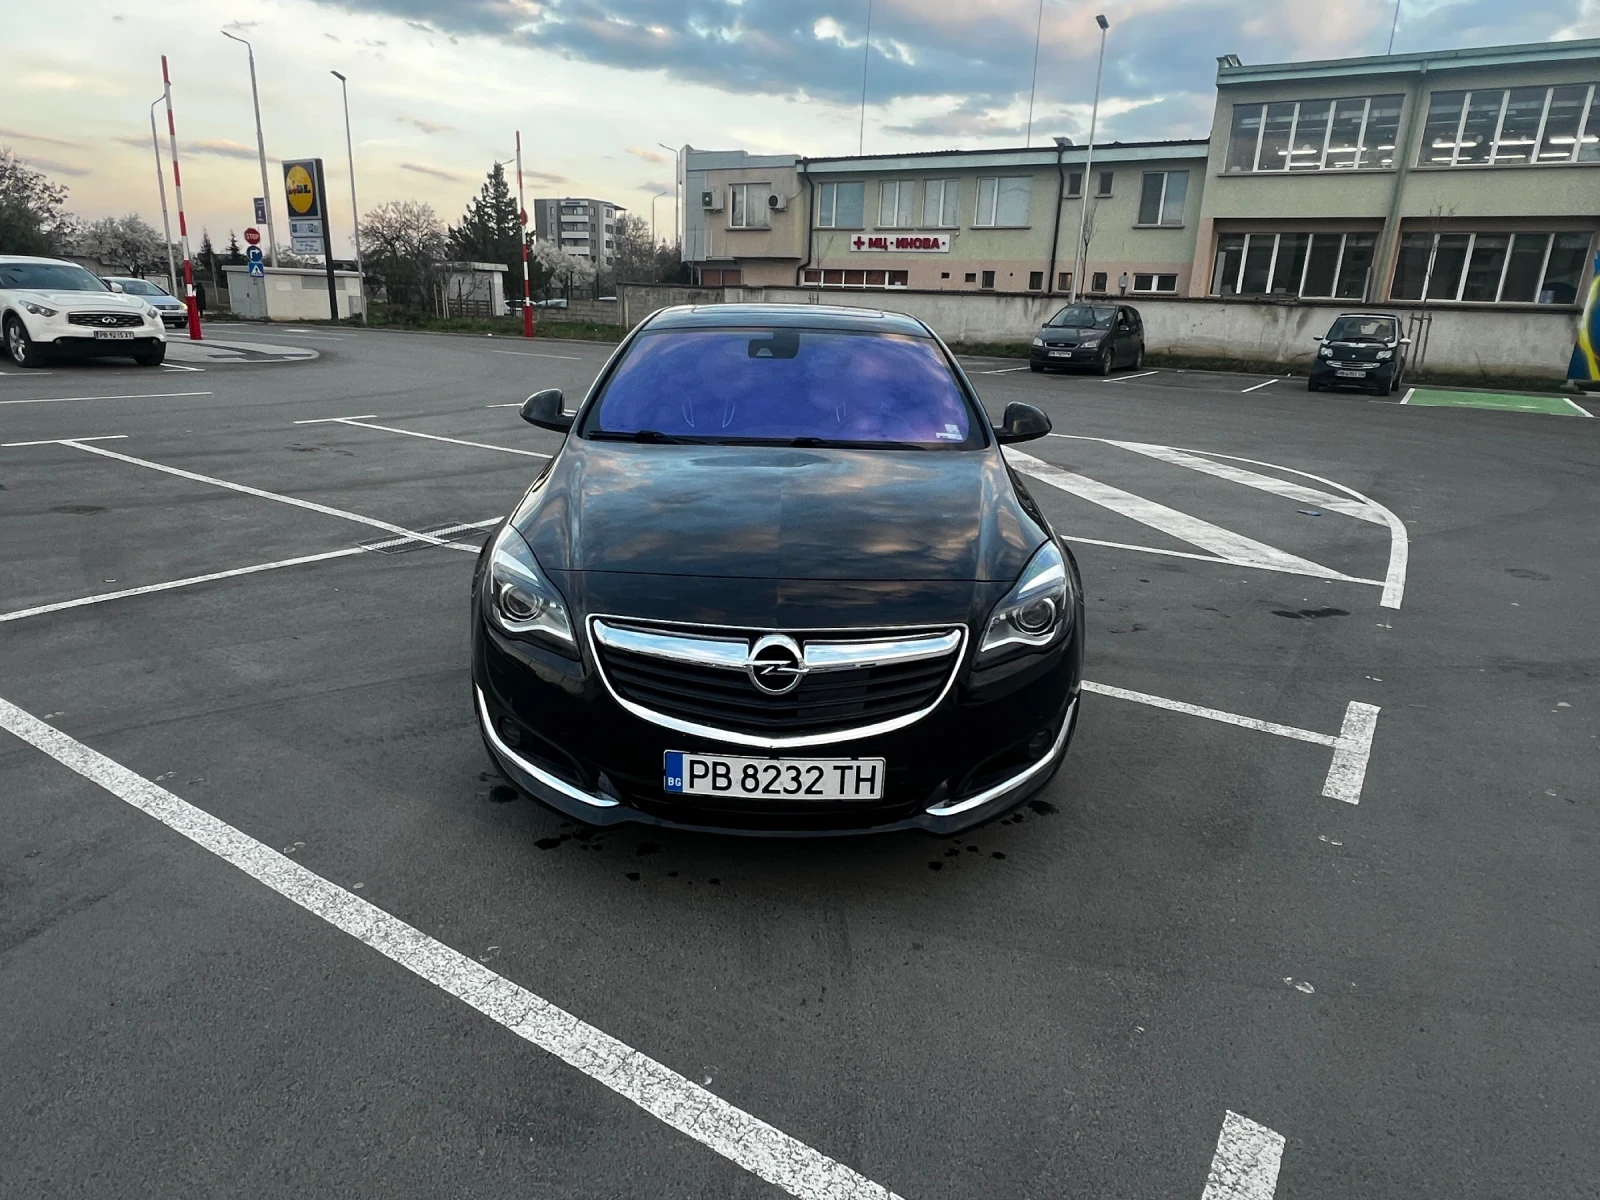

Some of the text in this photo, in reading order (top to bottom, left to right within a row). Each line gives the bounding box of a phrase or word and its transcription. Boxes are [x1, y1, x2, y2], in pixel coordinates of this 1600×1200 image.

[868, 237, 940, 250] МЦ ИНОВА
[668, 777, 682, 787] BG
[689, 759, 877, 795] PB 8232 TH
